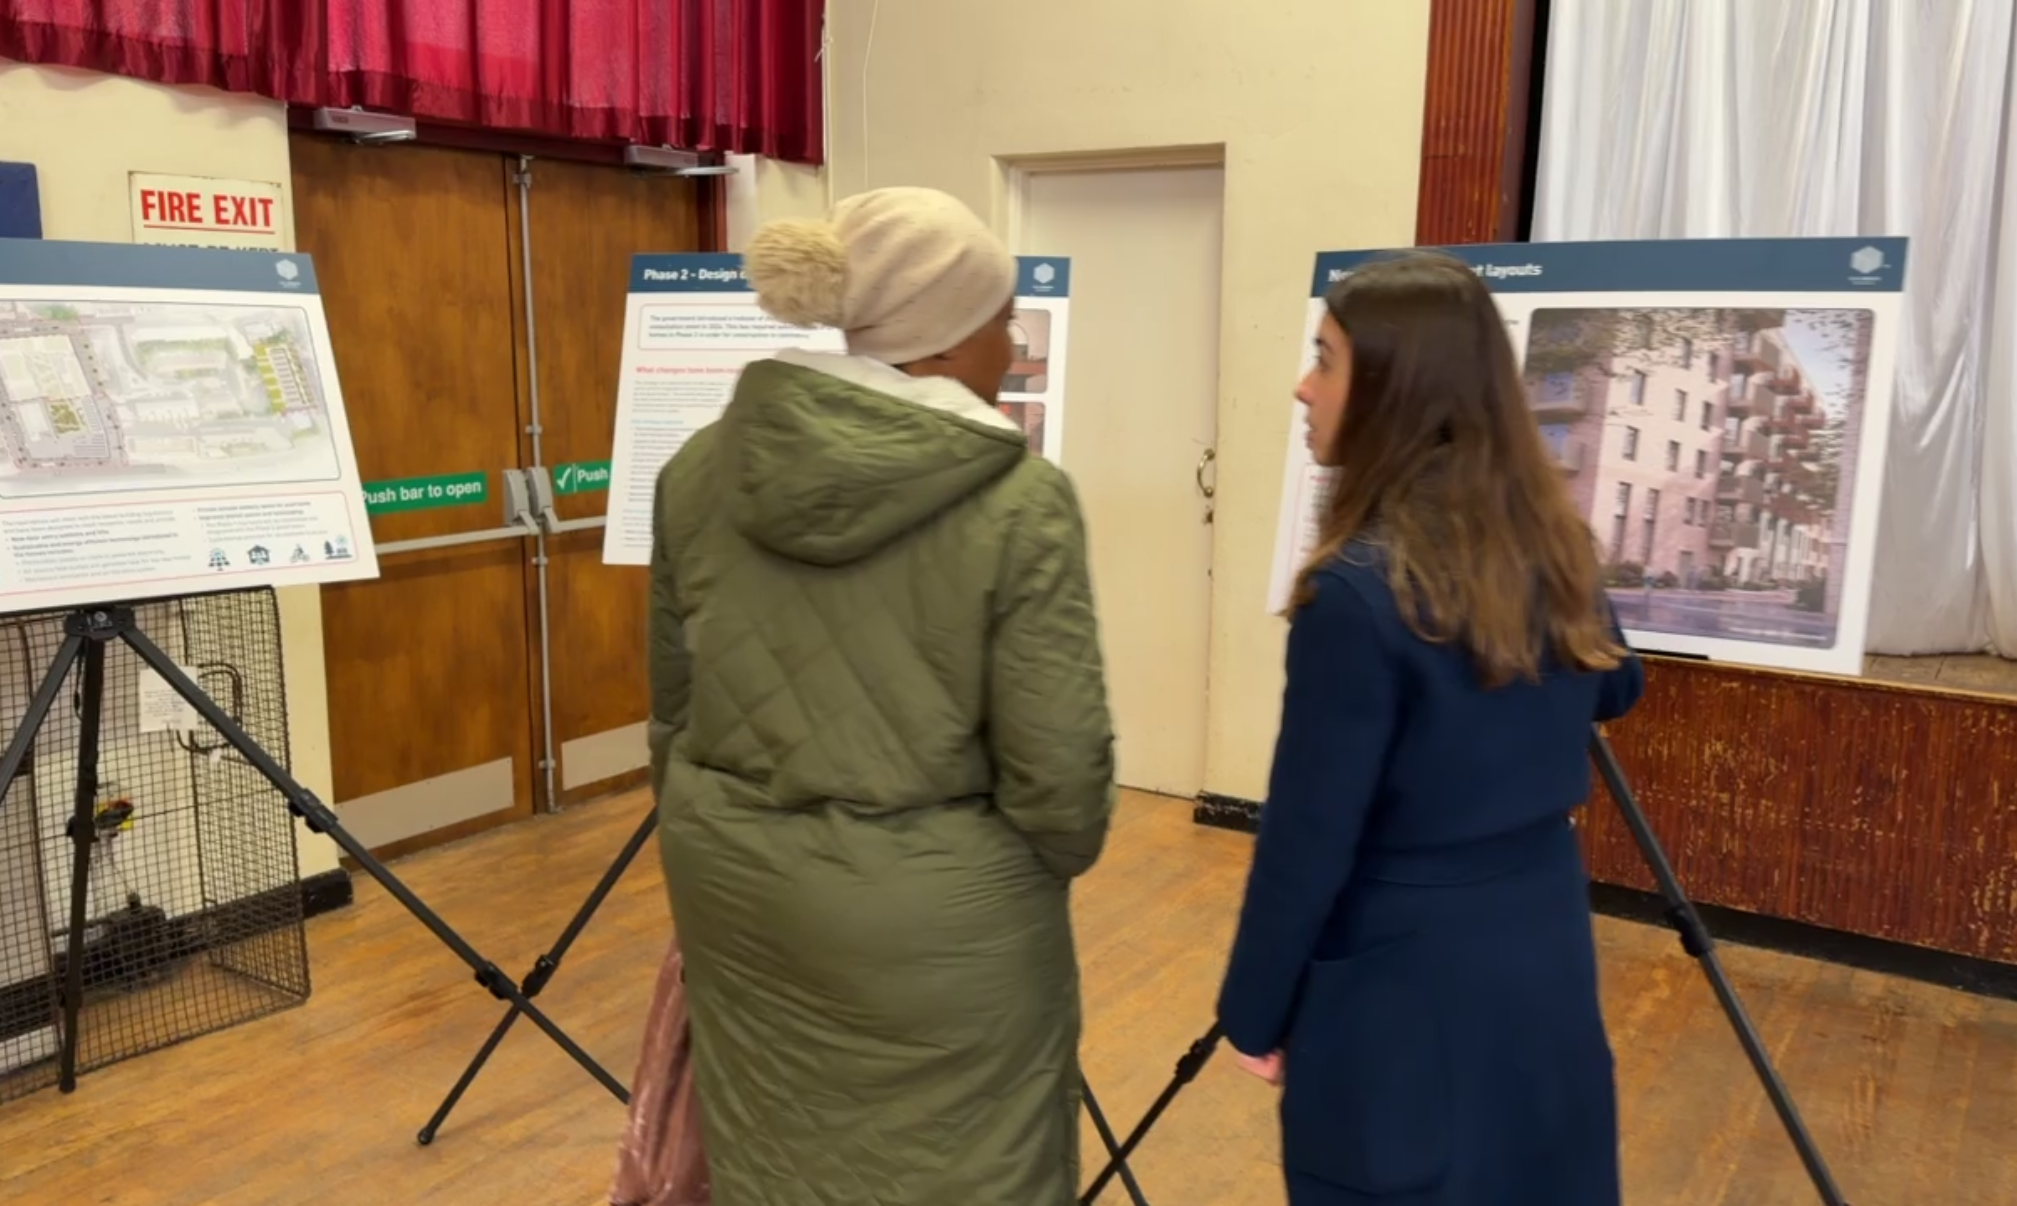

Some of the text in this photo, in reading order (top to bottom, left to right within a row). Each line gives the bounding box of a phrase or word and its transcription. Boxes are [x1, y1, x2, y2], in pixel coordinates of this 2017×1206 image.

[140, 189, 273, 227] FIRE EXIT
[644, 269, 678, 280] Phase
[681, 269, 688, 280] 2
[698, 268, 737, 282] Design
[1485, 264, 1542, 279] layouts
[636, 366, 654, 374] What
[577, 468, 608, 482] Push
[400, 486, 424, 500] bar
[428, 484, 442, 498] to
[446, 482, 482, 498] open
